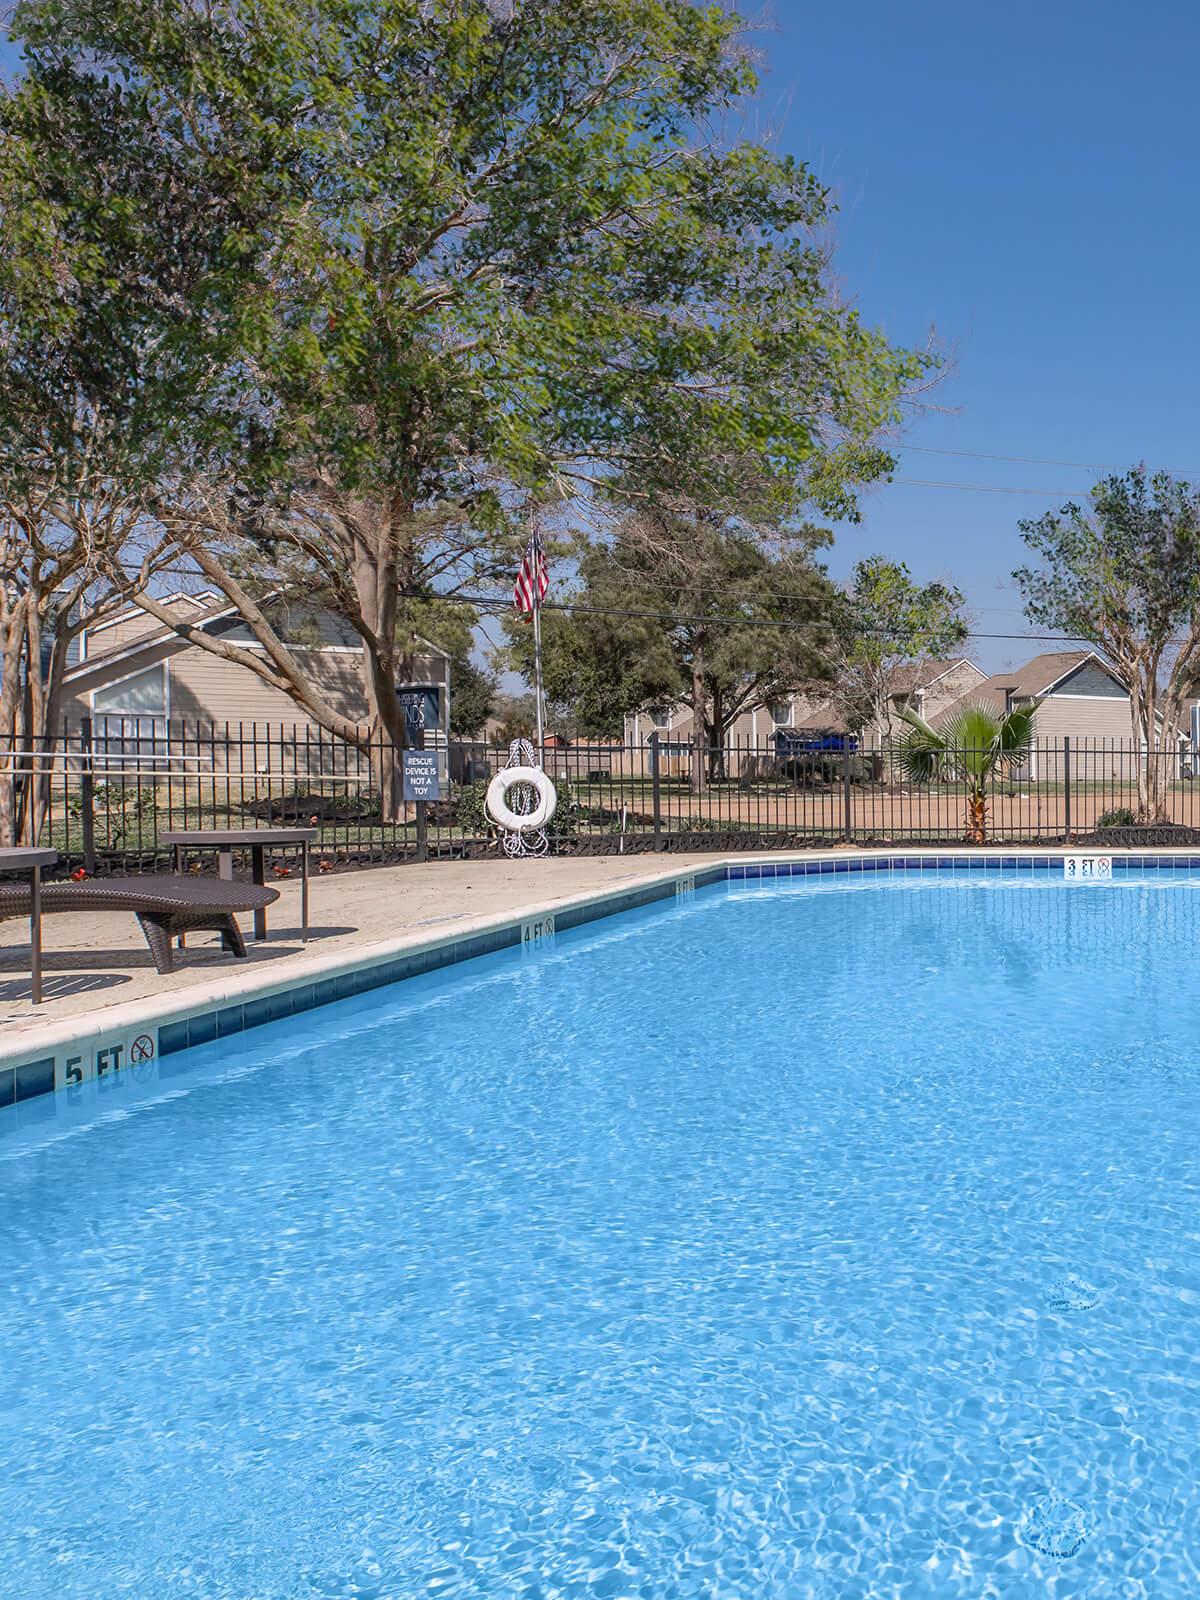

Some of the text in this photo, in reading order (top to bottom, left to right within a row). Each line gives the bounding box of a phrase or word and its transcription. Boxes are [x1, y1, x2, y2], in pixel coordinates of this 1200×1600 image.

[407, 757, 433, 765] RESCUE
[405, 767, 437, 775] DEVICE IS
[410, 777, 432, 785] NOT A
[414, 787, 429, 795] TOY
[1068, 859, 1095, 870] 3 FT
[534, 922, 544, 939] FT
[65, 1044, 124, 1085] 5 FT
